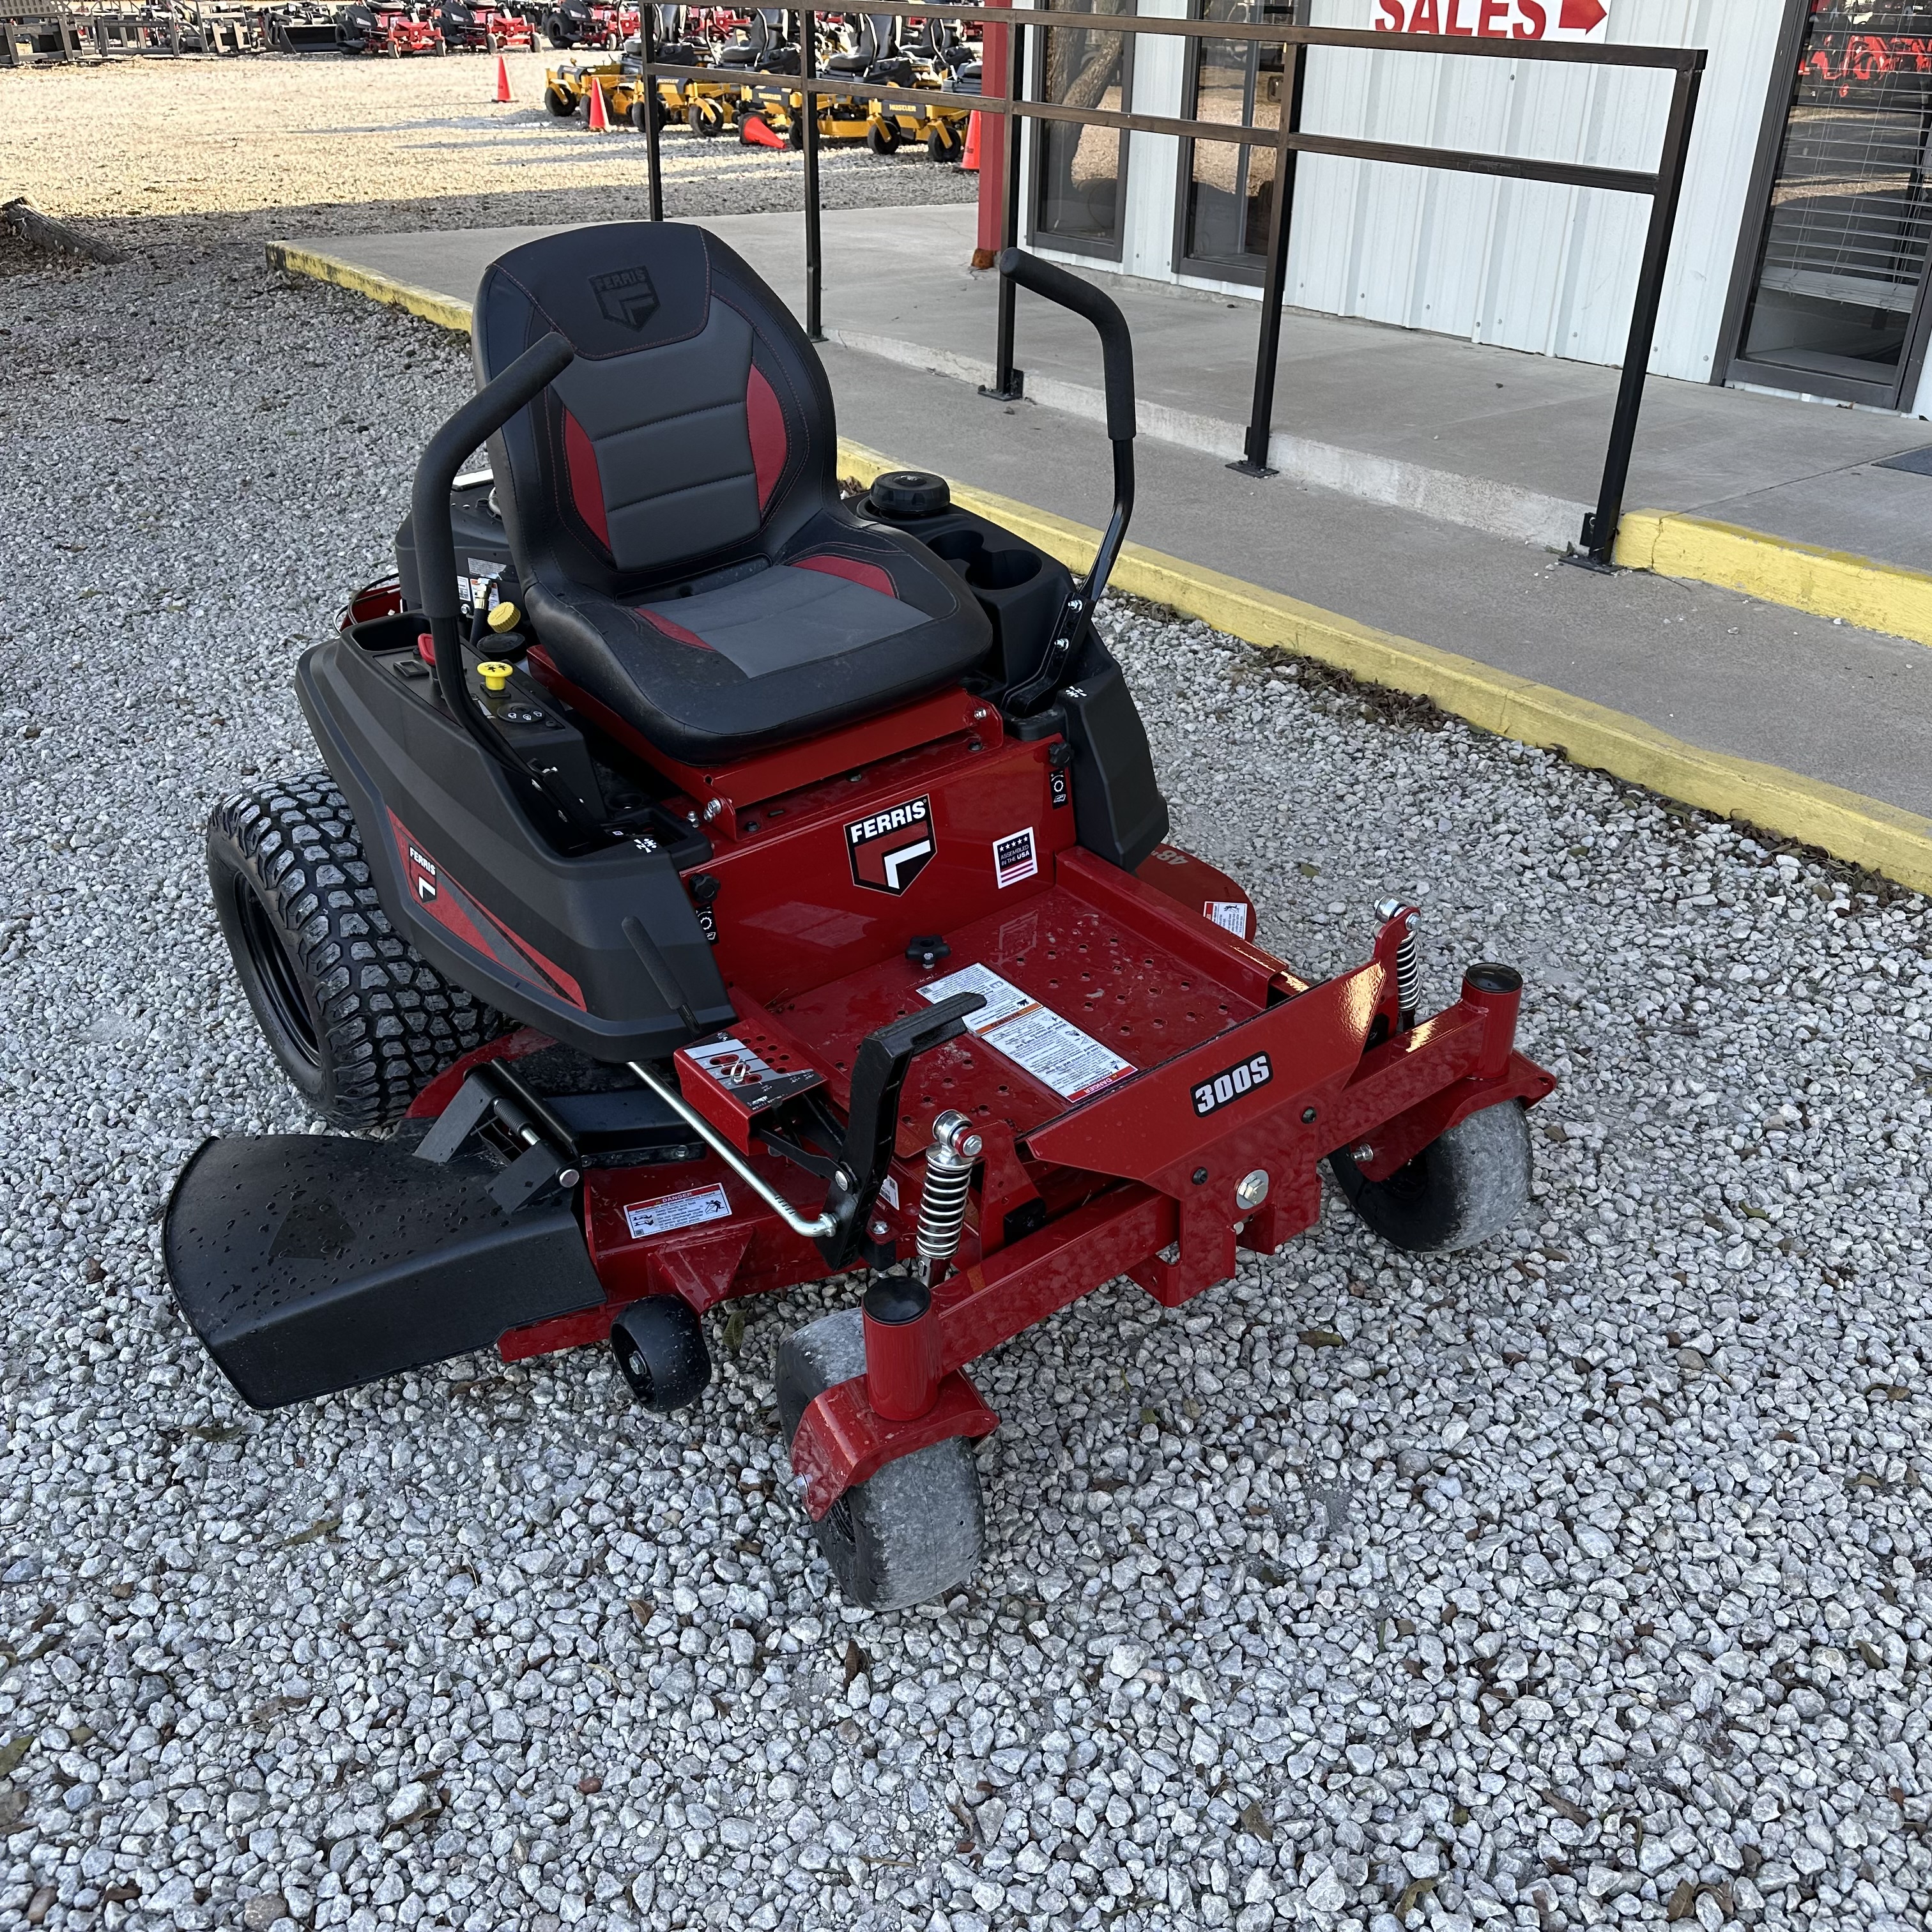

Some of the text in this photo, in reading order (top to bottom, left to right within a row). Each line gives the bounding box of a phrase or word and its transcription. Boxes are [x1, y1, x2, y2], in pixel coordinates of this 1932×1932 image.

[1375, 0, 1547, 40] SALES
[595, 268, 646, 291] FERRIS
[410, 847, 436, 875] FERRIS
[1000, 844, 1029, 860] ASSEMBLED
[1007, 855, 1016, 864] THE
[1016, 850, 1030, 860] USA
[1084, 1078, 1112, 1092] DANGER
[1195, 1055, 1269, 1113] 300S
[662, 1192, 693, 1203] DANGER
